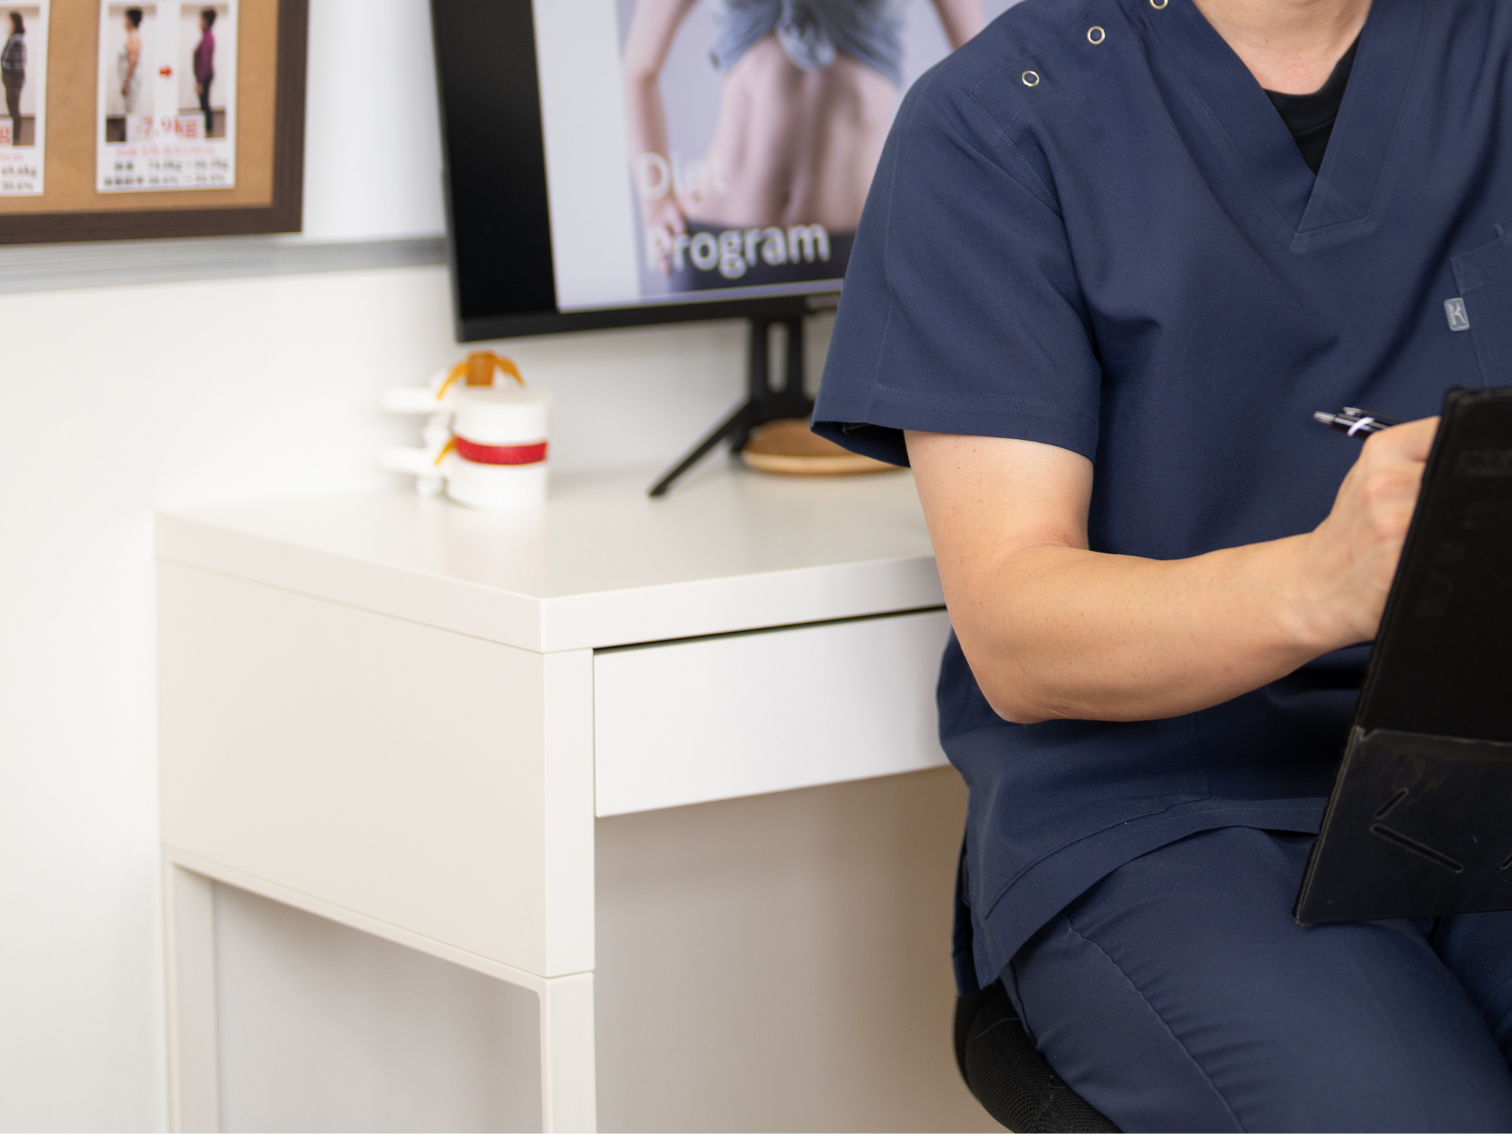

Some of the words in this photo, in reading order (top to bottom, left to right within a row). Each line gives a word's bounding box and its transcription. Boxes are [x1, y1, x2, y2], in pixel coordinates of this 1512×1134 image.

[136, 115, 198, 140] -7.9kg
[641, 150, 728, 201] Diet
[646, 224, 831, 279] Program
